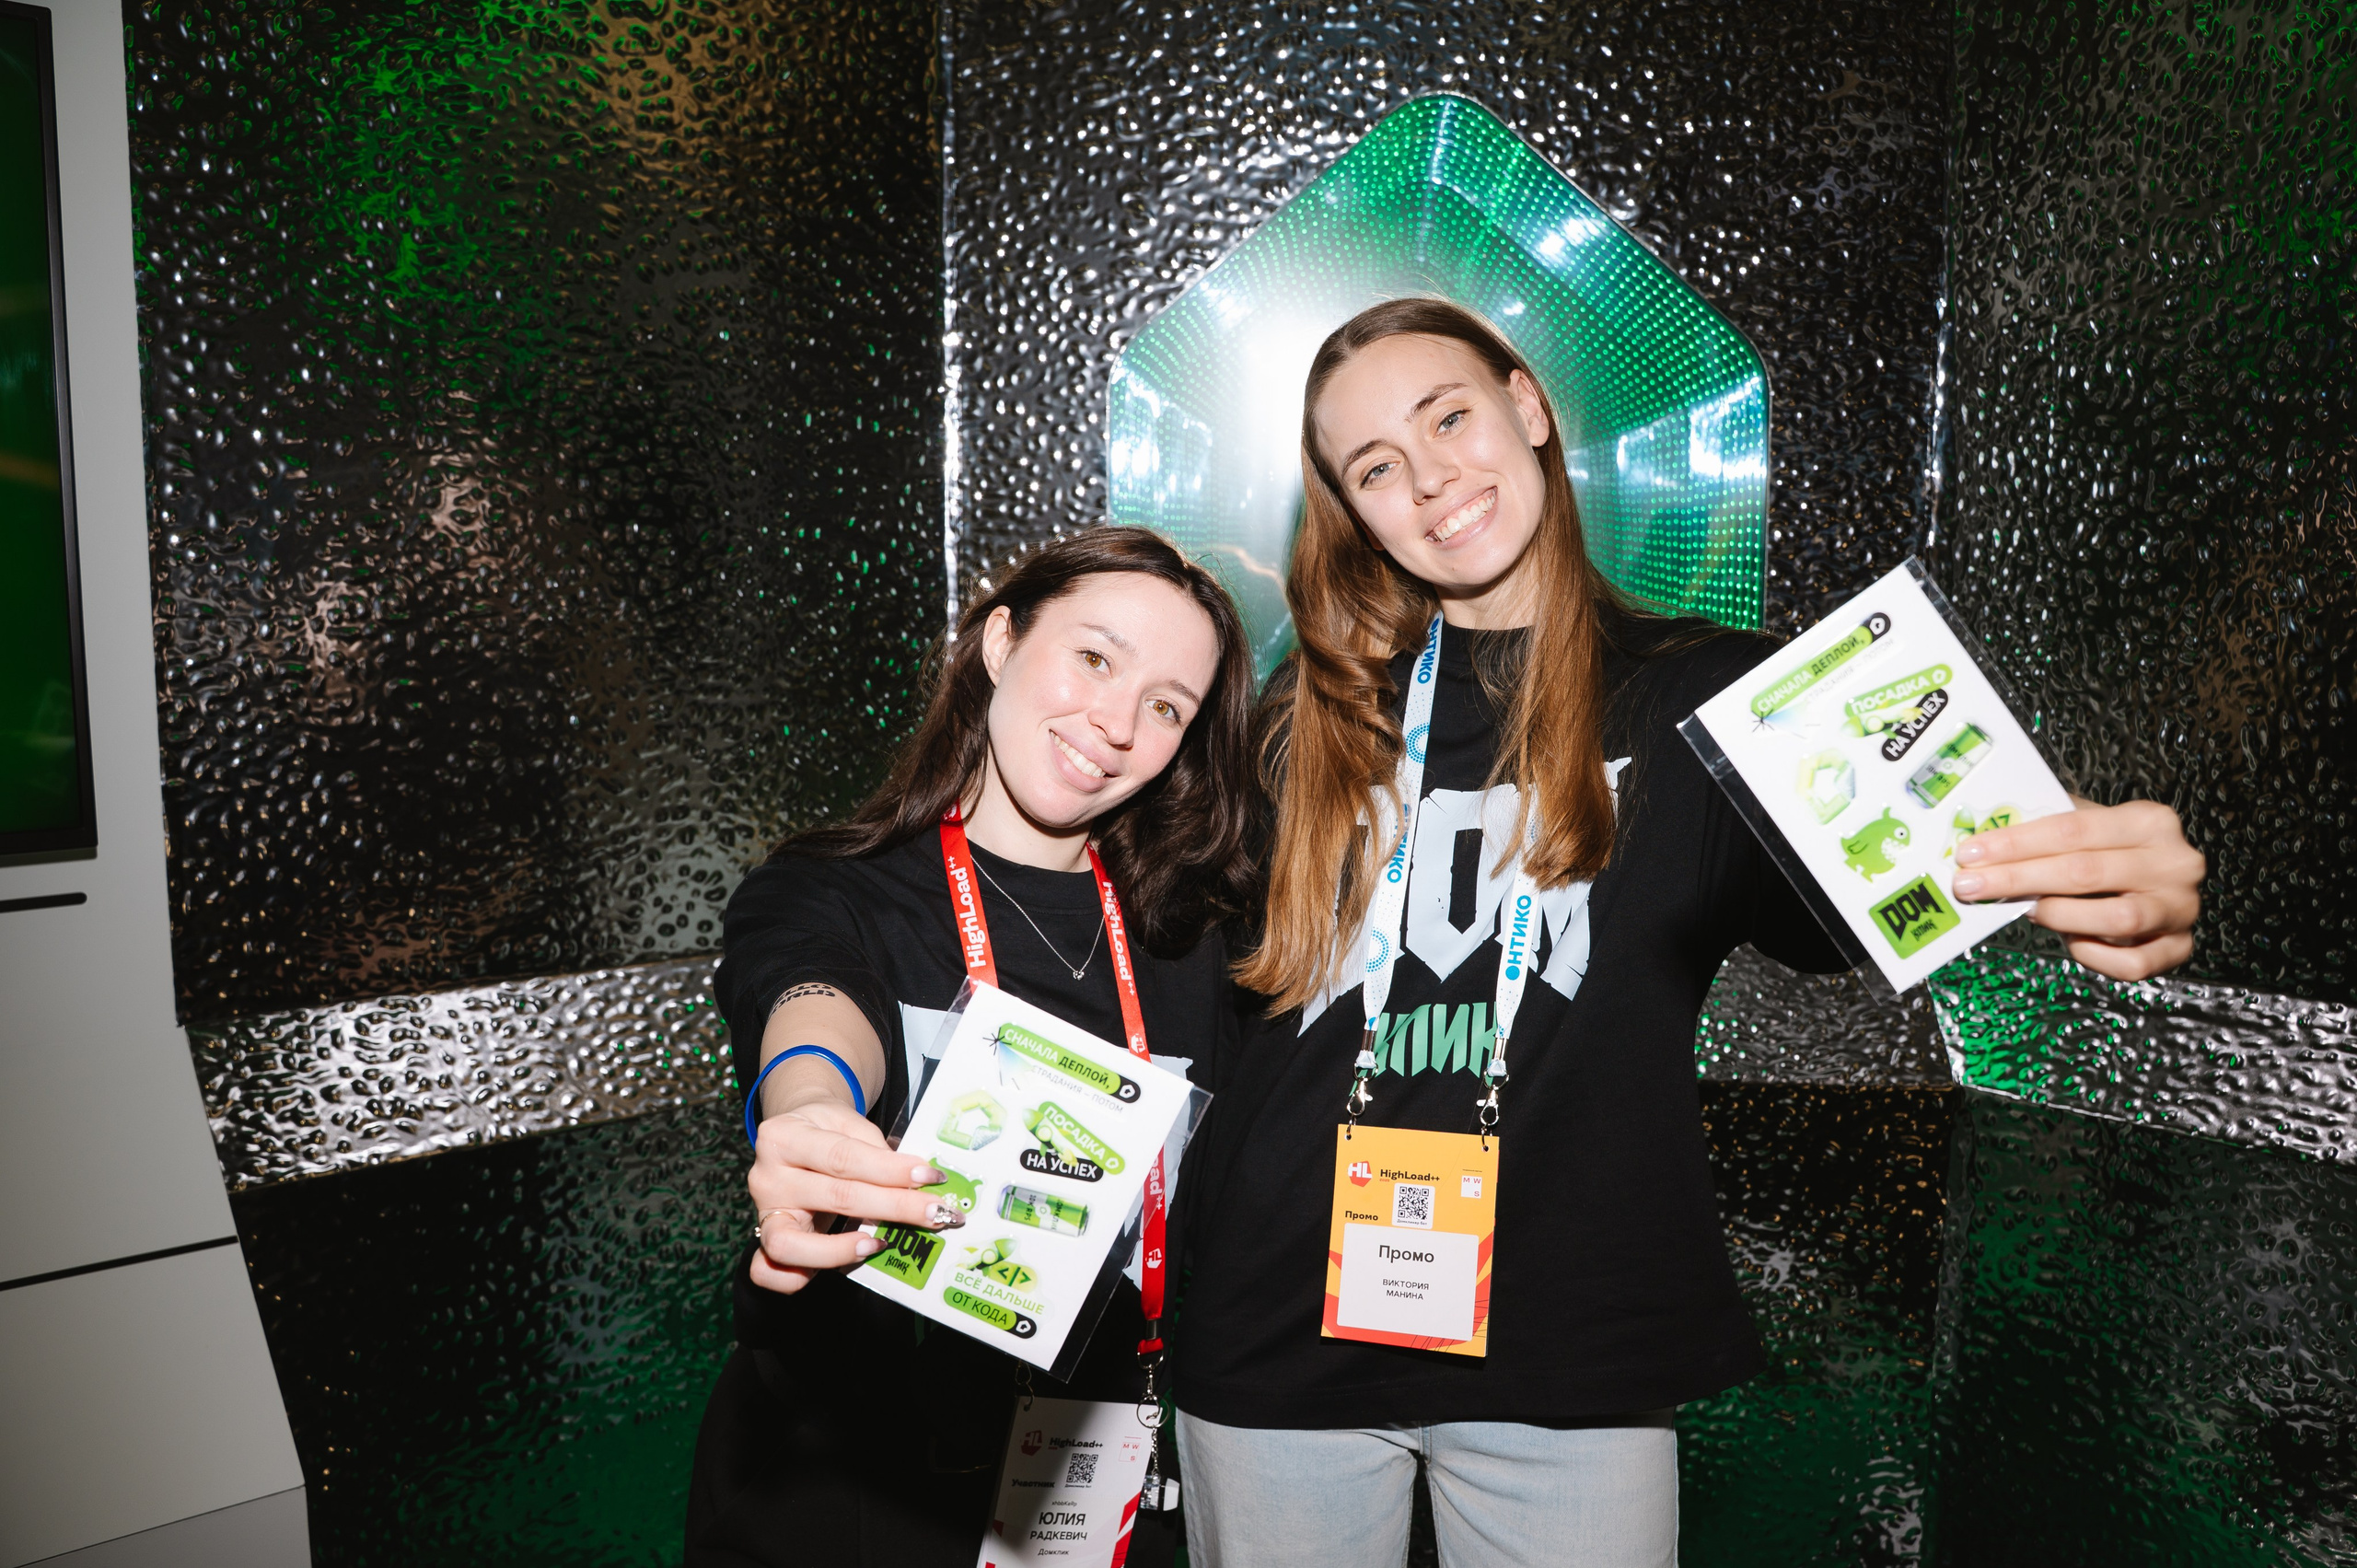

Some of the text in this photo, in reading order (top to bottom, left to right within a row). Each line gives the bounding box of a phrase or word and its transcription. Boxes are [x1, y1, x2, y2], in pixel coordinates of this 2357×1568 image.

[1757, 635, 1864, 713] СНАЧАЛА ДЕПЛОЙ,
[1851, 676, 1931, 715] ПОСАДКА
[1886, 691, 1945, 758] НА УСПЕХ
[947, 855, 986, 968] HighLoad++
[1004, 1028, 1110, 1089] СНАЧАЛА ДЕПЛОЙ,
[1031, 1065, 1082, 1094] СТРАДАНИЯ
[1092, 1094, 1123, 1113] ПОТОМ
[1044, 1106, 1106, 1160] ПОСАДКА
[1027, 1153, 1097, 1179] НА УСПЕХ
[1380, 1168, 1440, 1181] HighLoad++
[1345, 1210, 1378, 1222] Промо
[1378, 1245, 1434, 1263] Промо
[954, 1272, 1045, 1315] ВСЁ ДАЛЬШЕ
[1382, 1278, 1430, 1291] ВИКТОРИЯ
[1386, 1290, 1424, 1300] МАНИНА
[952, 1292, 1007, 1325] ОТ КОДА
[1049, 1437, 1103, 1448] HighLoad++
[1012, 1479, 1055, 1489] Участник
[1039, 1512, 1086, 1526] ЮЛИЯ
[1029, 1530, 1087, 1541] РАДКЕВИЧ
[1038, 1548, 1069, 1557] Домклик
